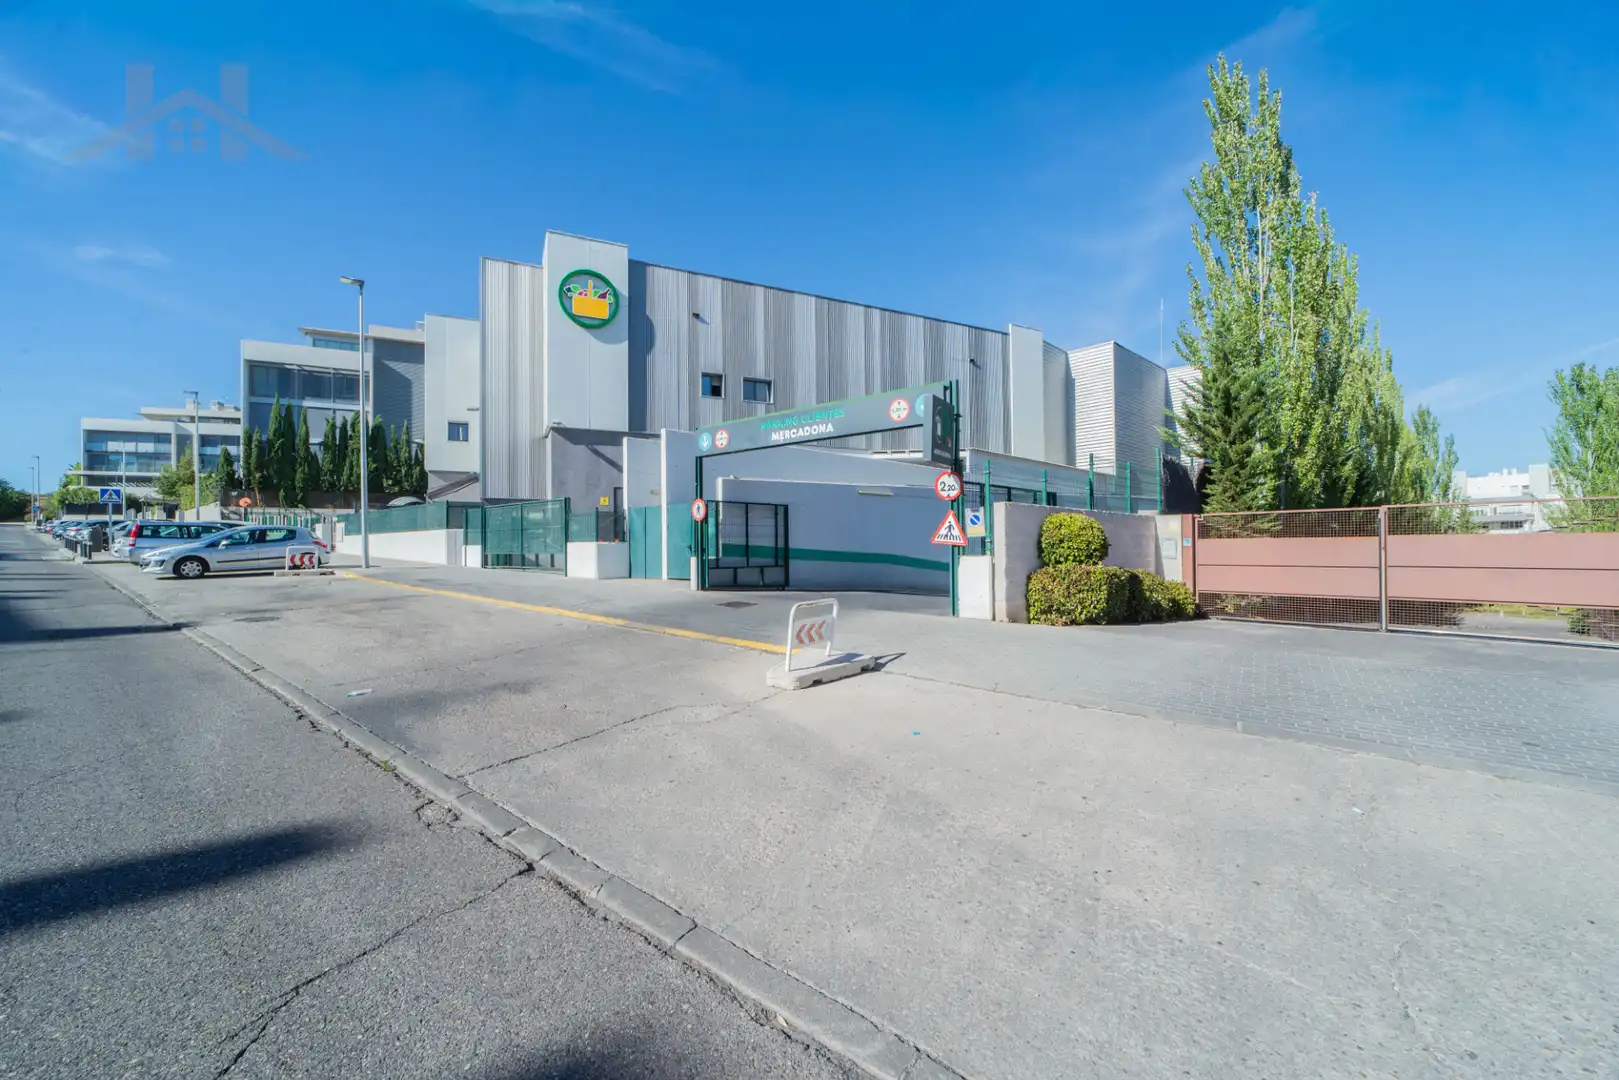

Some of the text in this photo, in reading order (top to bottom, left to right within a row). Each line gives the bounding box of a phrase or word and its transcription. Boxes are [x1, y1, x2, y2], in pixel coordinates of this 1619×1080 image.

[761, 407, 845, 430] PARKING CLIENTES
[771, 423, 834, 441] MERCADONA
